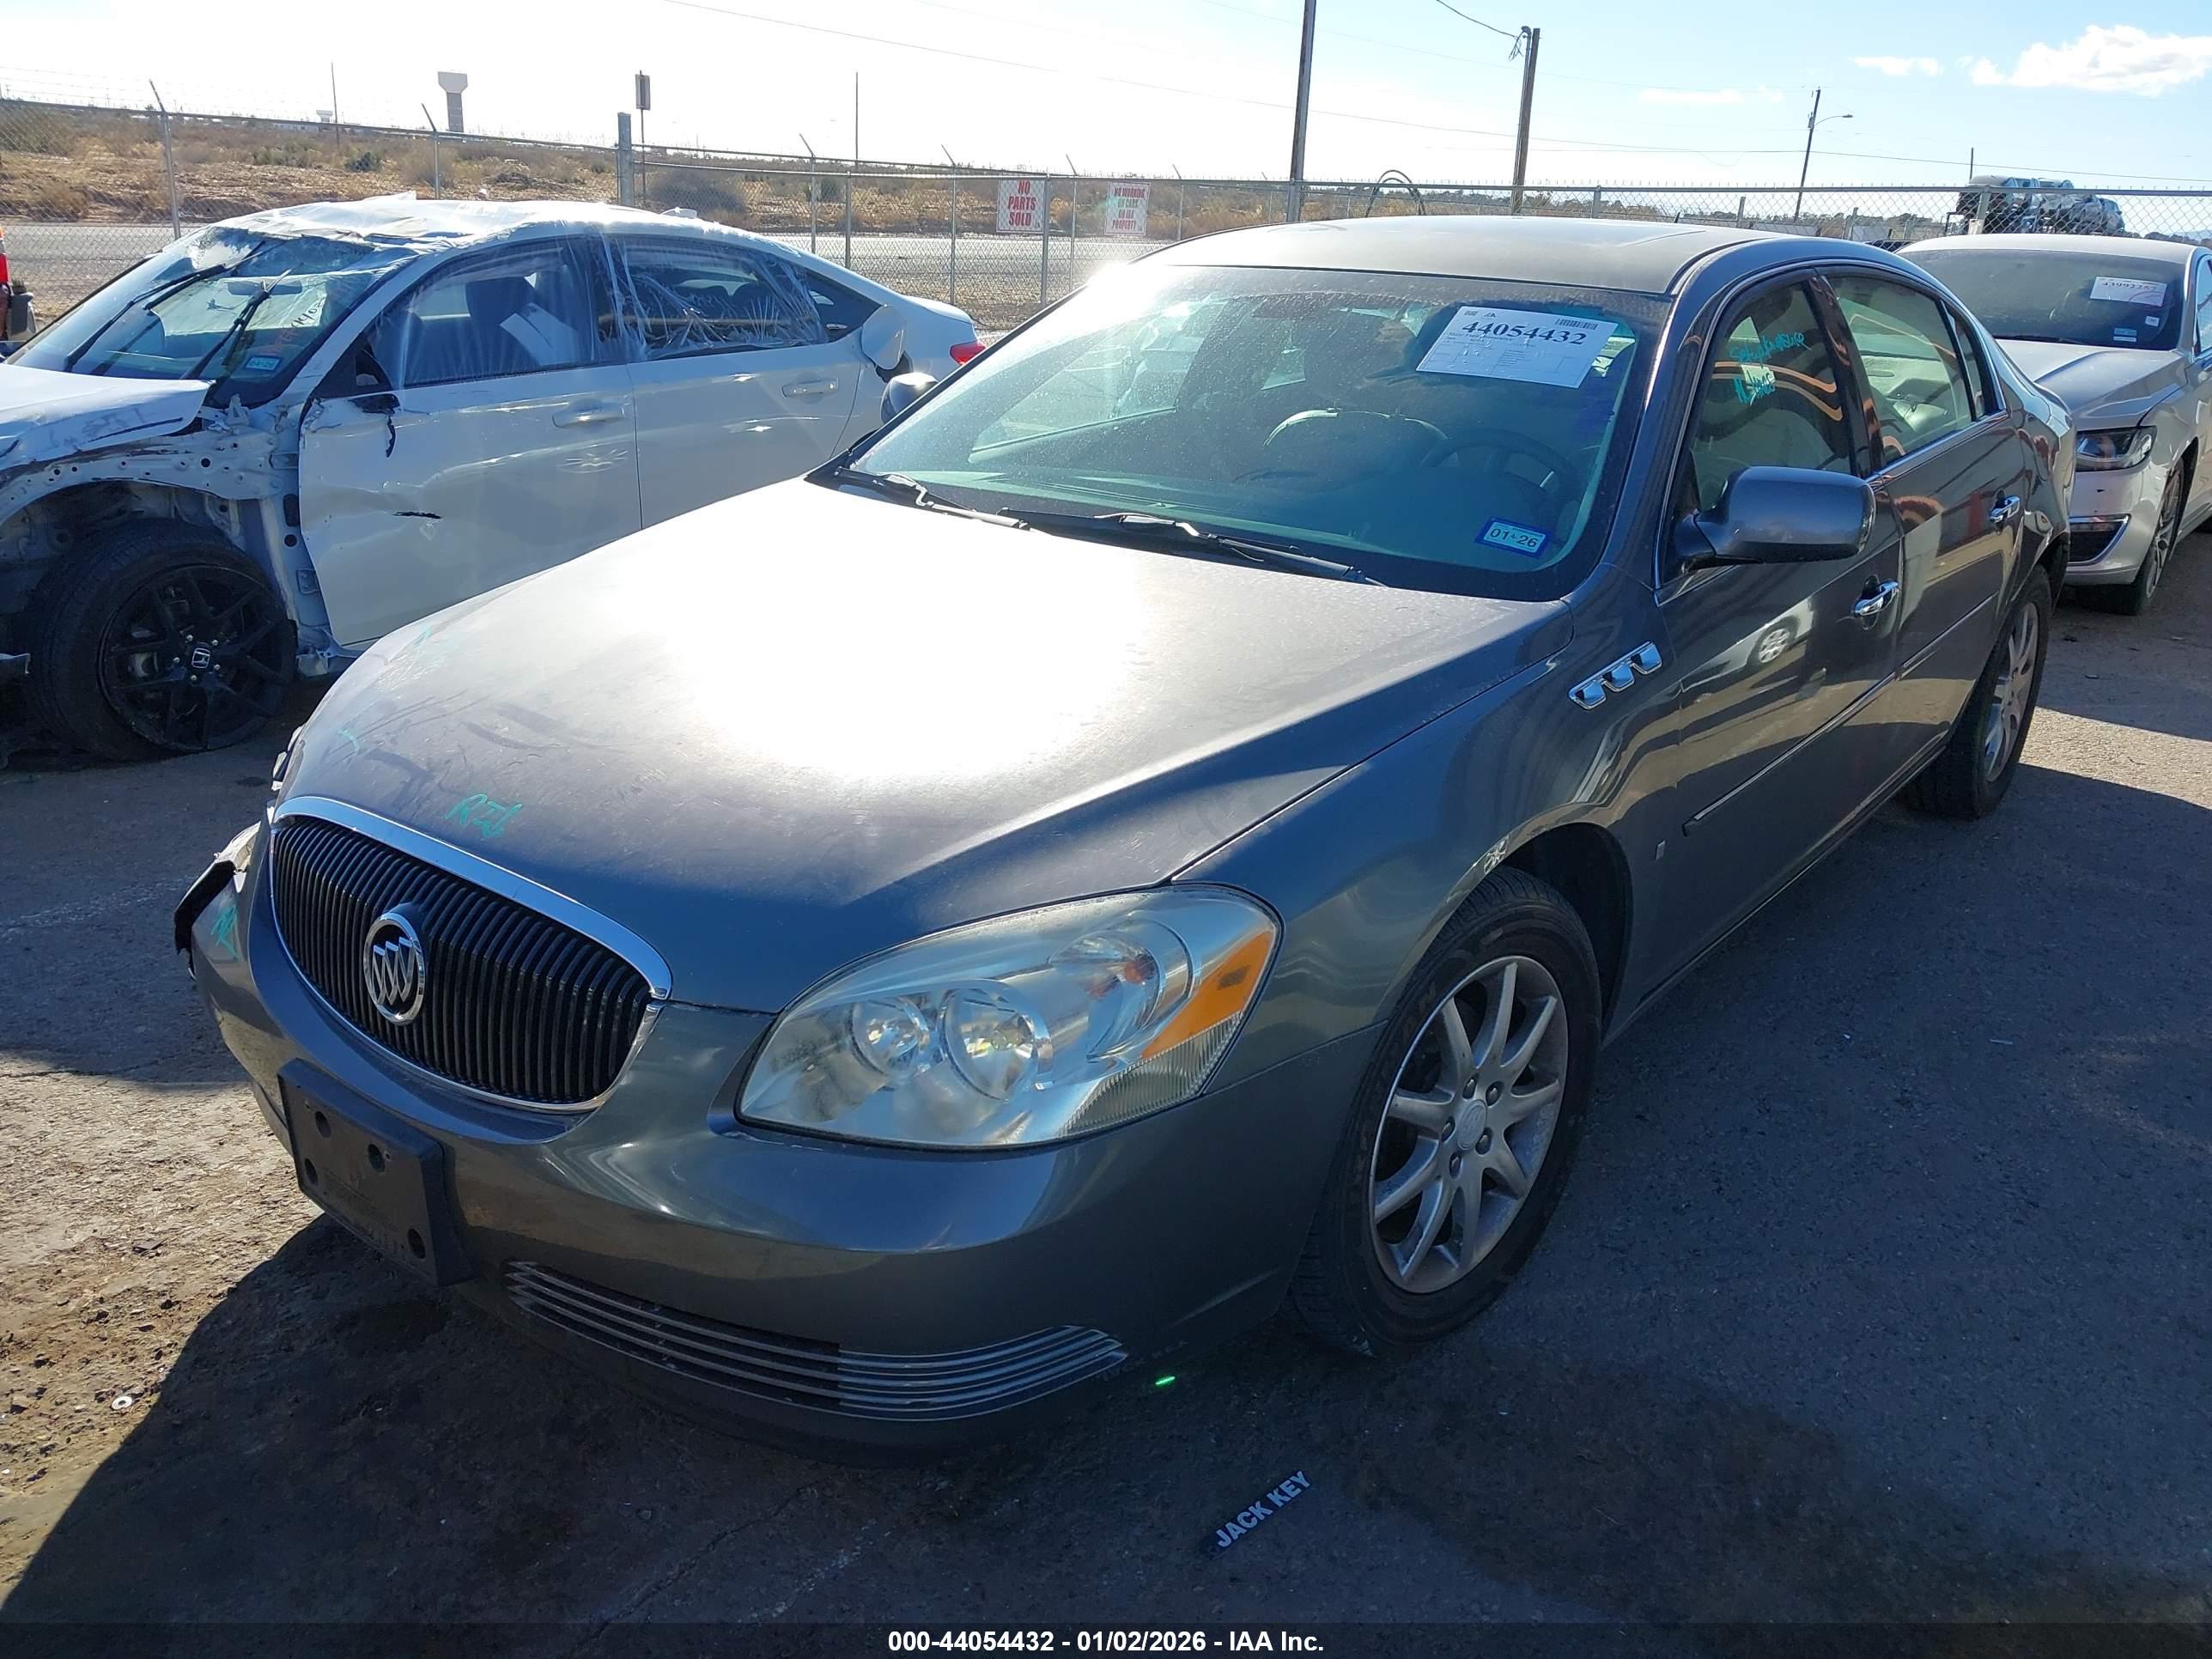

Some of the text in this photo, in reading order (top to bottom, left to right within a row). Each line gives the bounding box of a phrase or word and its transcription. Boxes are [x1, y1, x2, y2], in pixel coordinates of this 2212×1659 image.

[1018, 179, 1030, 194] NO
[1114, 187, 1146, 198] NO WORKING
[1007, 196, 1036, 210] PARTS
[1118, 198, 1139, 209] ON CARS
[1008, 211, 1032, 227] SOLD
[1118, 209, 1125, 219] ON
[1112, 219, 1137, 231] PROPERTY
[1462, 320, 1588, 345] 44054432
[1216, 1471, 1310, 1547] JACK KEY
